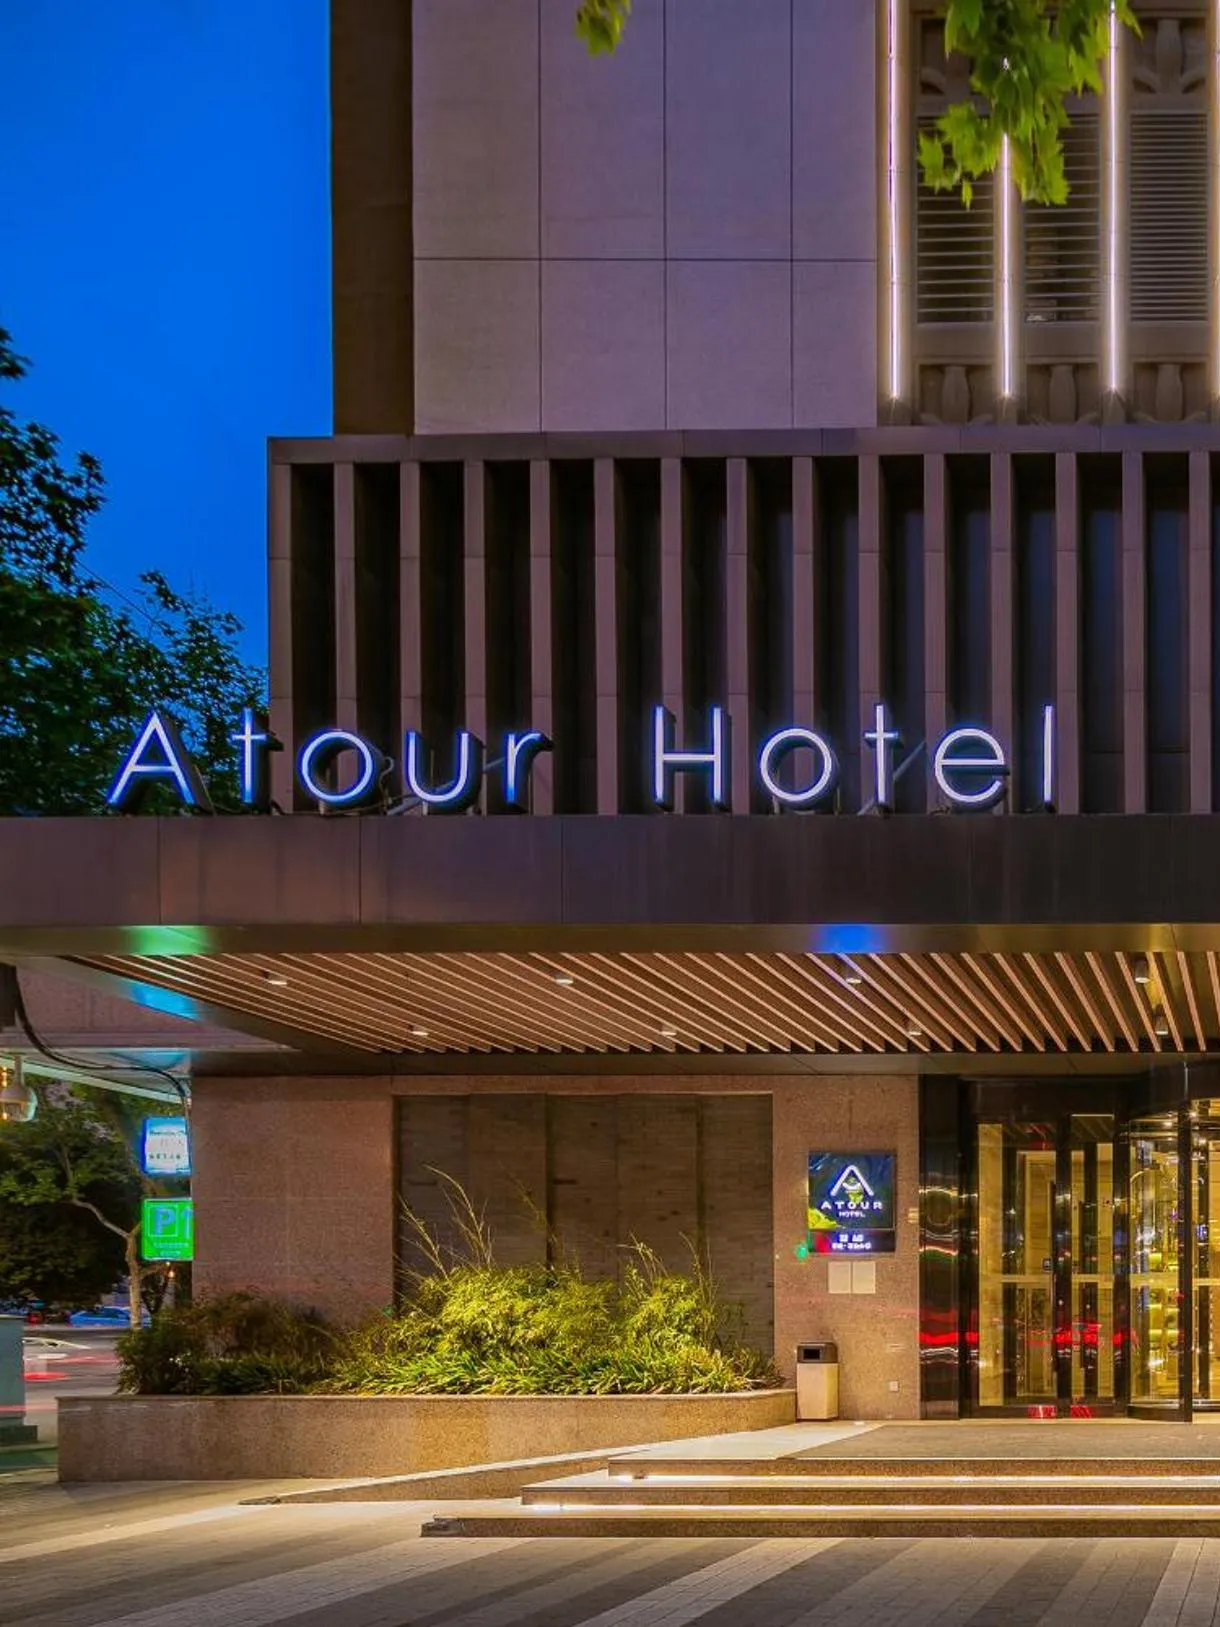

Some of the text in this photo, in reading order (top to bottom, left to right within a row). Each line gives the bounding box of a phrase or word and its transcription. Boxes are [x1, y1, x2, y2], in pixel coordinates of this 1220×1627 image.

[107, 705, 1055, 807] Atour Hotel
[820, 1200, 883, 1210] ATOUR
[155, 1207, 175, 1236] P
